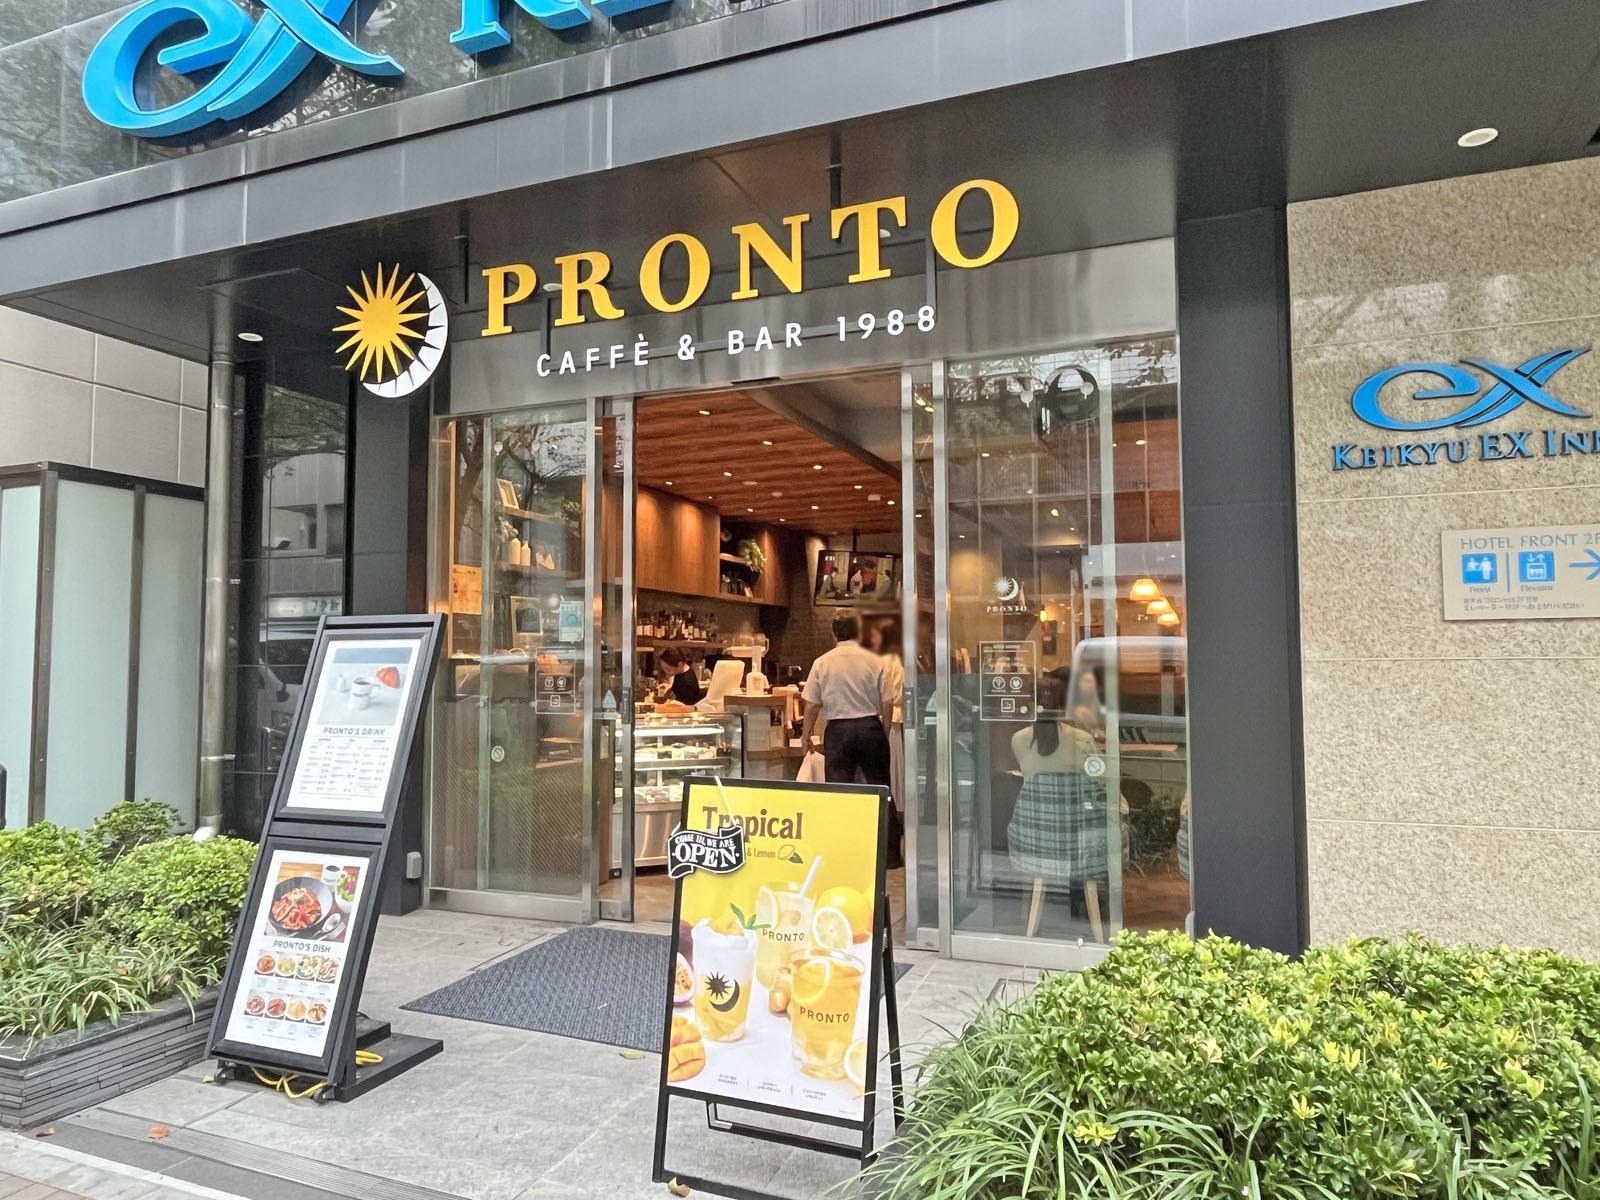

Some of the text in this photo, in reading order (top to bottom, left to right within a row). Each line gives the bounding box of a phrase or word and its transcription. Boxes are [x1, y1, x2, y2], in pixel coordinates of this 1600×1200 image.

[480, 178, 1020, 337] PRONTO
[537, 305, 937, 378] CAFFÈ & BAR 1988
[1332, 440, 1470, 470] KEIKYU
[1478, 430, 1536, 462] EX
[1460, 536, 1513, 549] HOTEL
[1520, 533, 1578, 547] FRONT
[323, 727, 386, 736] PRONTO'S DRINK
[675, 842, 737, 868] OPEN
[754, 847, 776, 859] Lemon
[762, 929, 805, 942] PRONTO
[273, 939, 331, 954] PRONTO'S DISH
[799, 1005, 850, 1024] PRONTO
